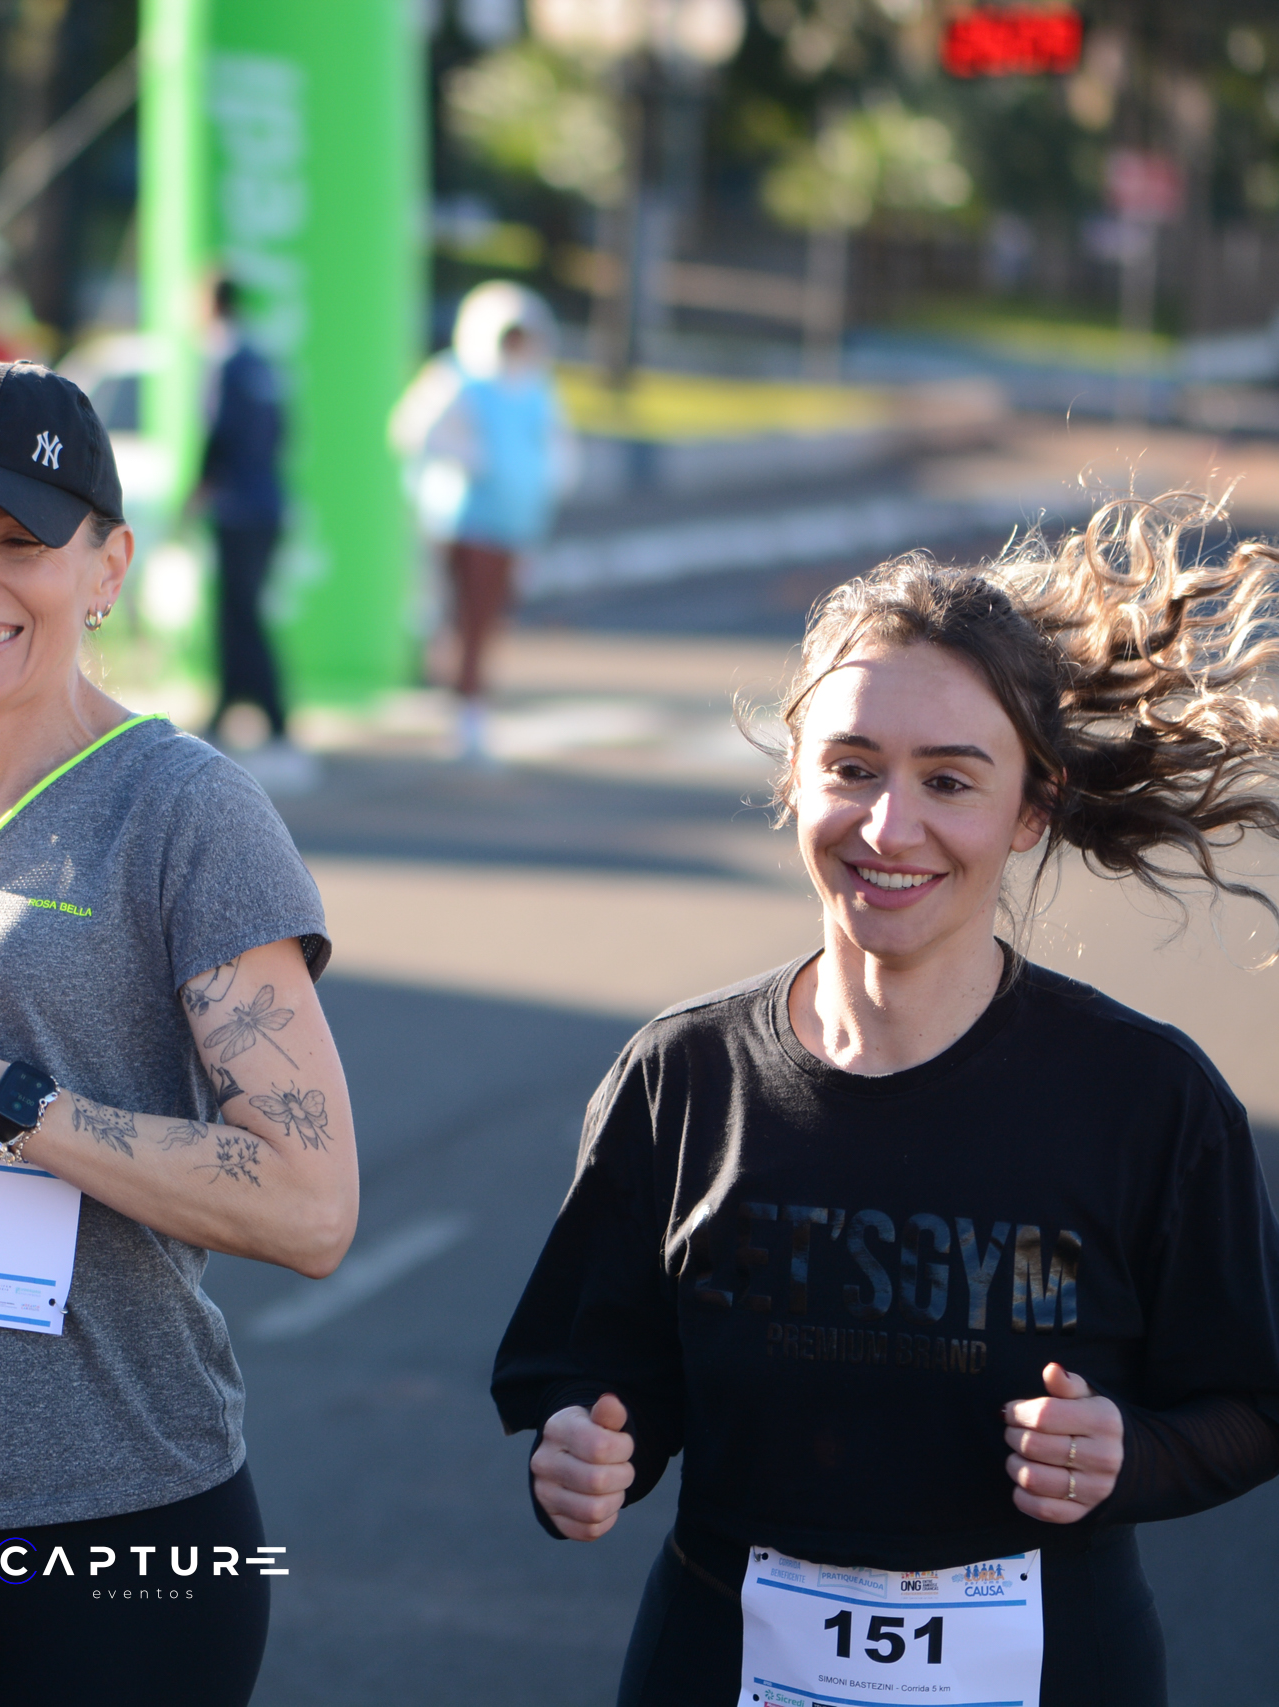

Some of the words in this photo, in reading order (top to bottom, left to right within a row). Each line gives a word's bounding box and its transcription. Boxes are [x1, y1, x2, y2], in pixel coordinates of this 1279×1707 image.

[32, 430, 63, 470] NY
[27, 898, 57, 910] ROSA
[59, 902, 92, 917] BELLA
[766, 1322, 888, 1366] PREMIUM
[896, 1333, 988, 1375] BRAND
[779, 1557, 801, 1570] CORRIDA
[770, 1568, 806, 1584] BENEFICENTE
[901, 1580, 921, 1592] ONG
[964, 1585, 1005, 1597] CAUSA
[824, 1609, 944, 1664] 151
[818, 1674, 847, 1686] SIMONI
[849, 1679, 894, 1691] BASTEZINI
[901, 1684, 930, 1692] Corrida
[939, 1684, 951, 1692] km
[776, 1693, 805, 1707] Sicredi
